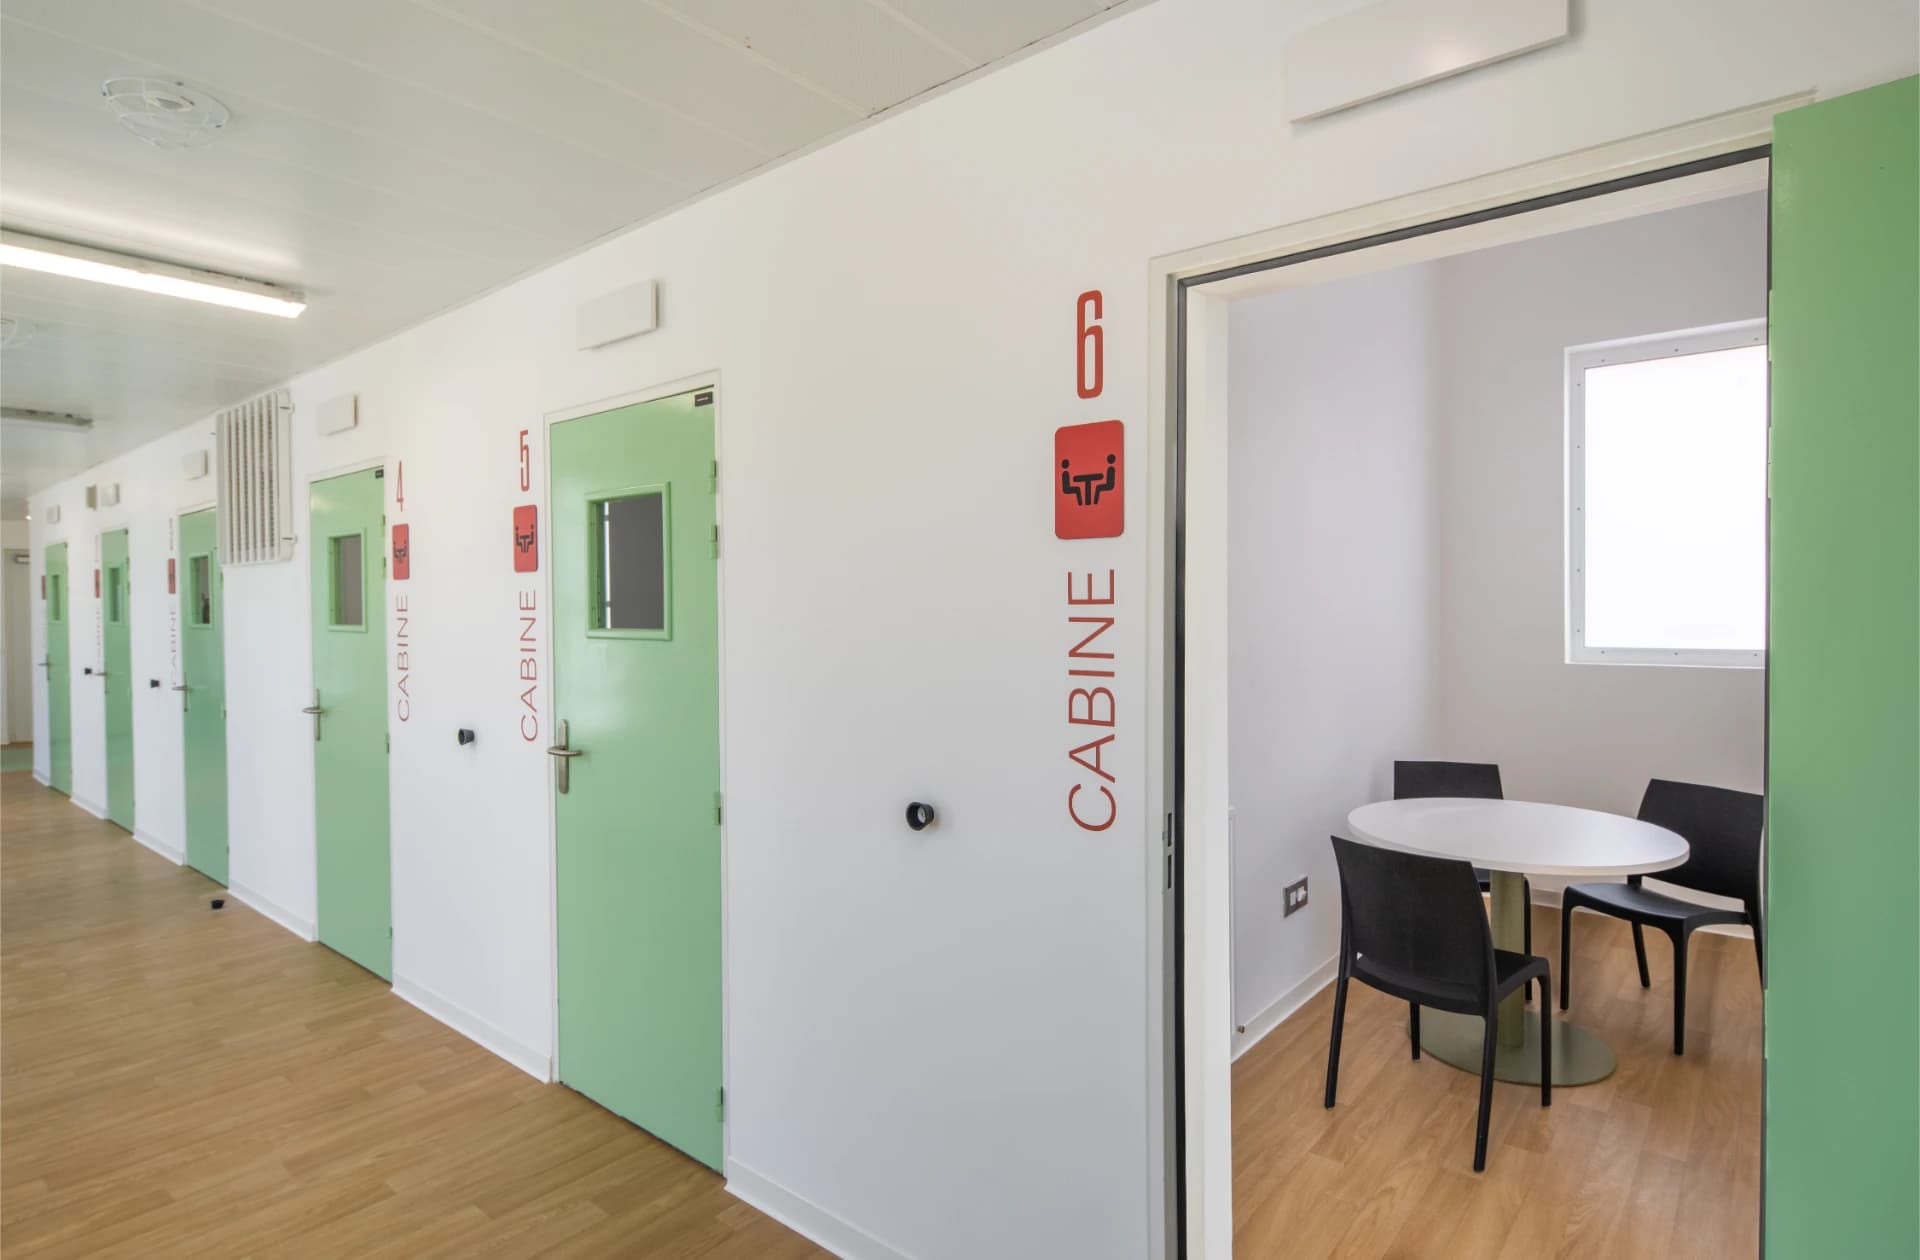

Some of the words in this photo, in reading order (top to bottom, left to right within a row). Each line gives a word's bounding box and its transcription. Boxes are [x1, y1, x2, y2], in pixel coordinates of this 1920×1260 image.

[1075, 288, 1104, 400] 6
[396, 460, 405, 512] 4
[519, 429, 530, 492] 5
[396, 594, 409, 722] CABINE
[519, 589, 538, 742] CABINE
[1067, 568, 1117, 832] CABINE
